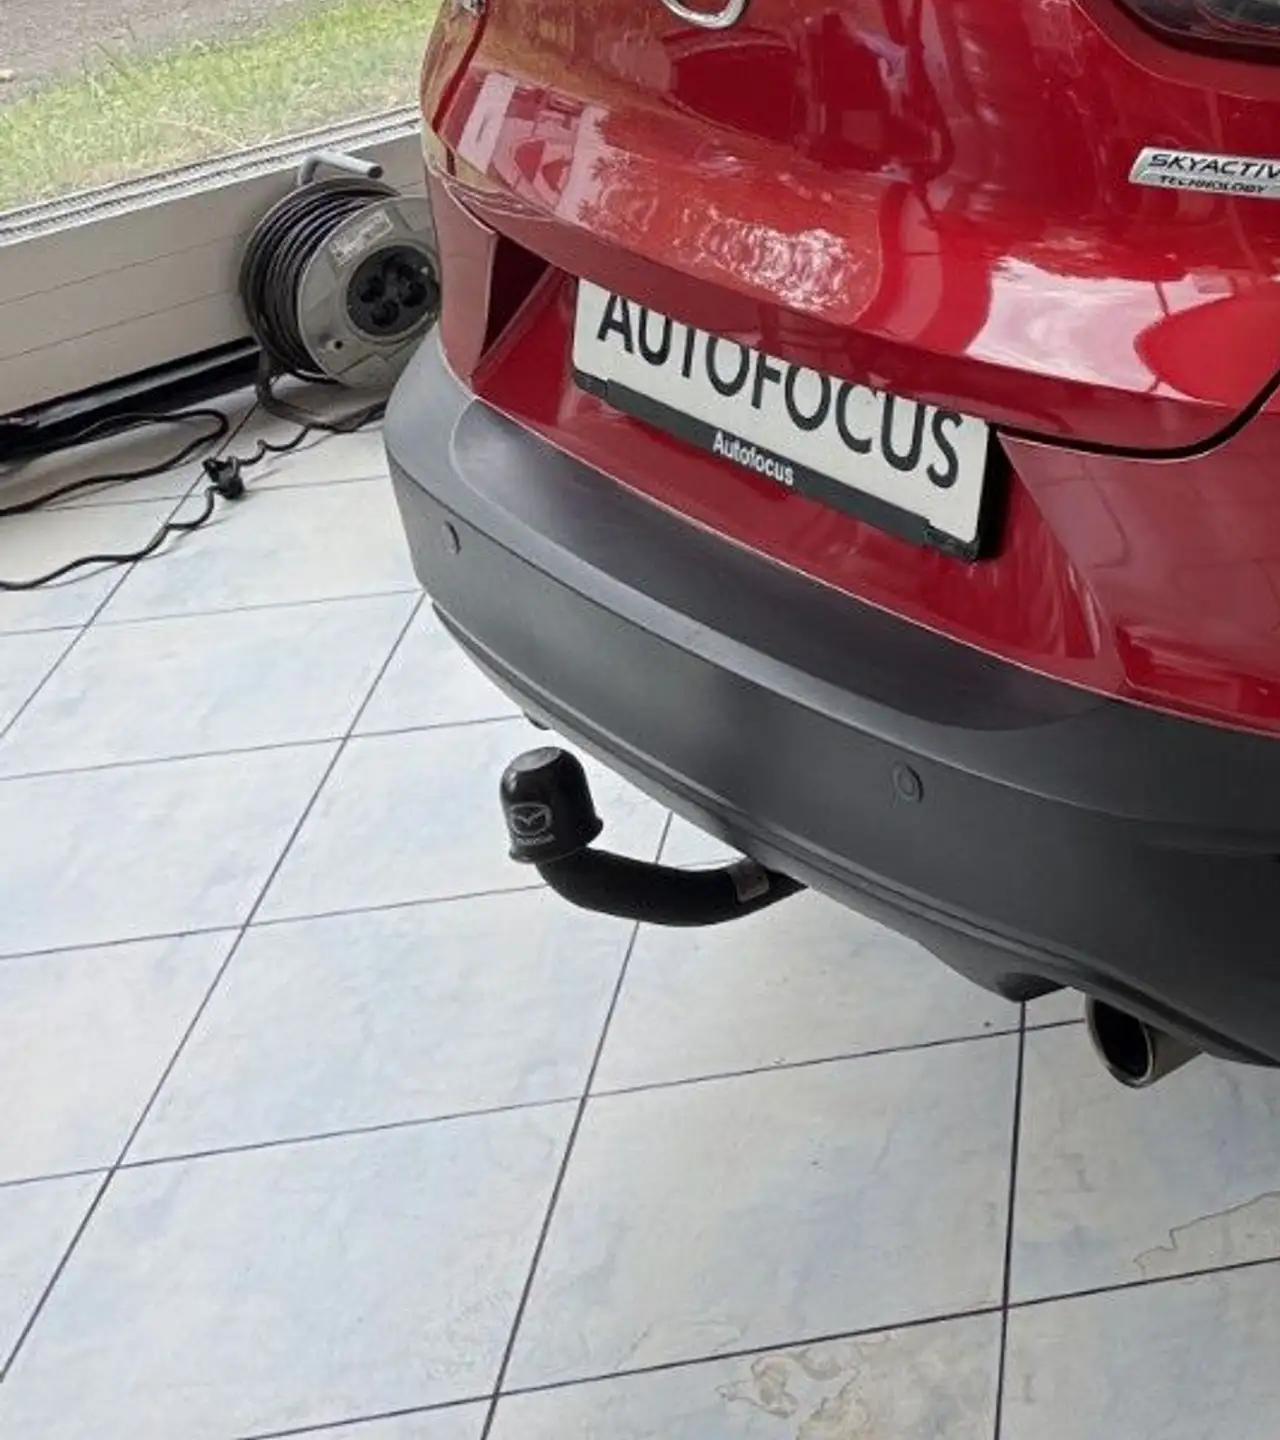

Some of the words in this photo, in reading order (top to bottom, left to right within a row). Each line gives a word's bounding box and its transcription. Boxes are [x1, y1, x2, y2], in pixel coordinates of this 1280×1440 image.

[1159, 174, 1268, 194] TECHNOLOGY
[596, 294, 963, 489] AUTOFOCUS
[712, 431, 795, 487] Autofocus
